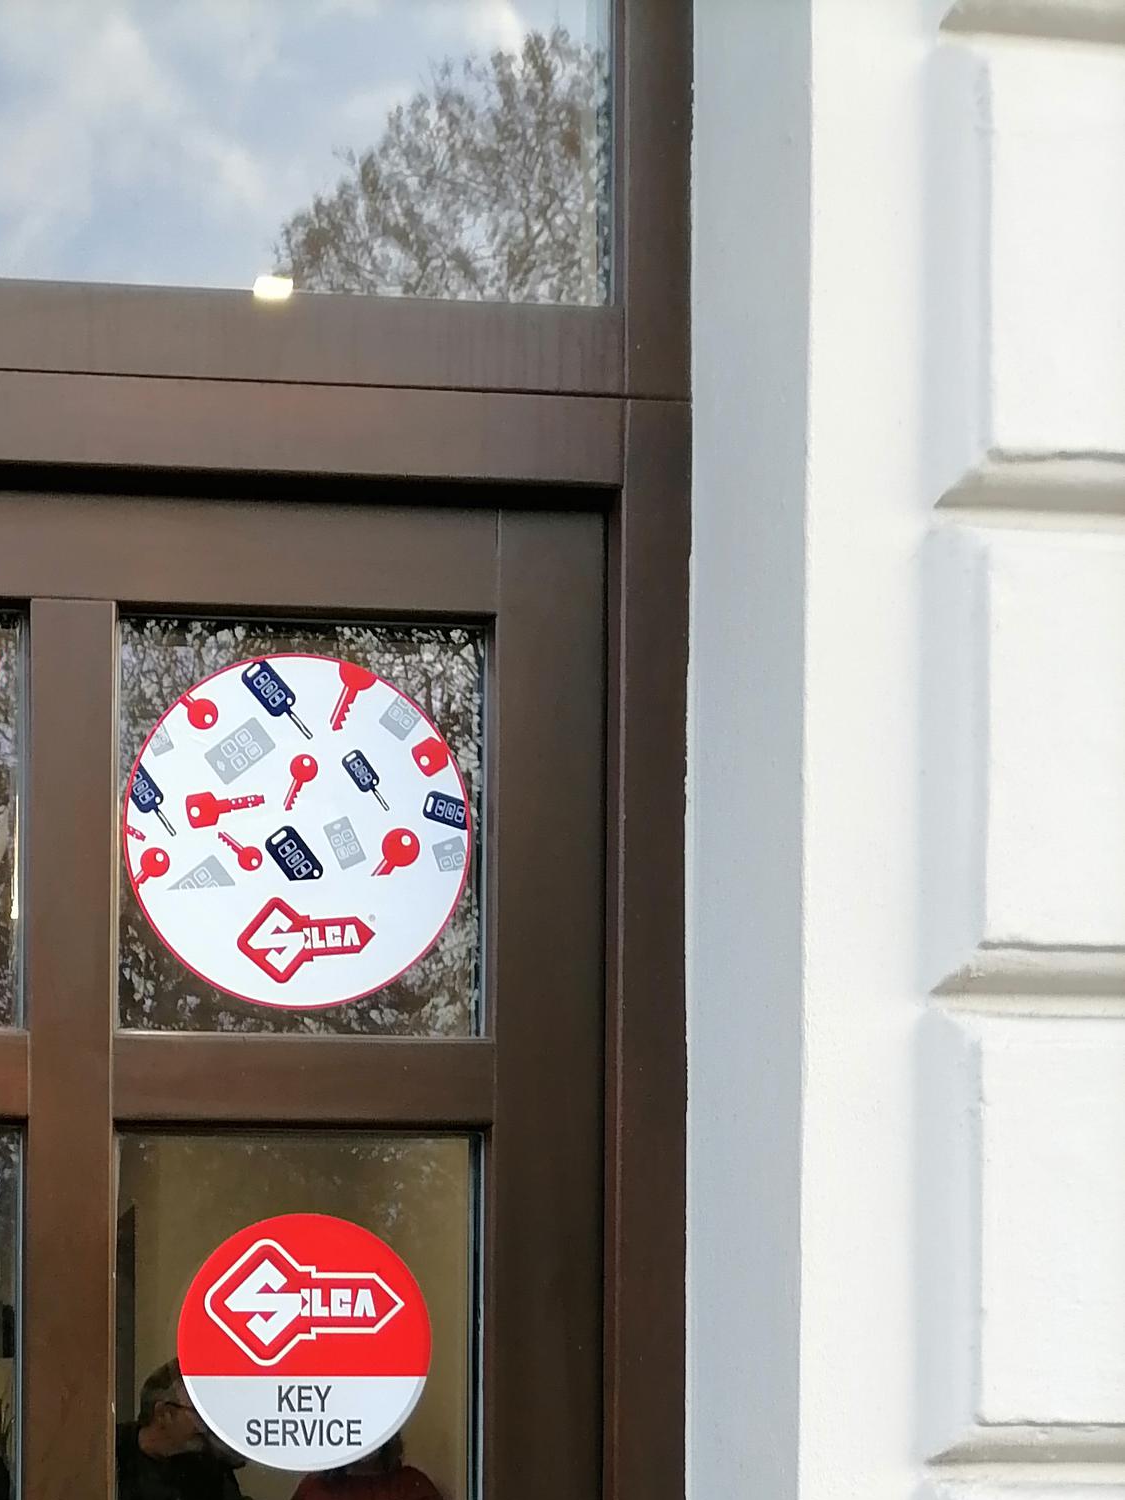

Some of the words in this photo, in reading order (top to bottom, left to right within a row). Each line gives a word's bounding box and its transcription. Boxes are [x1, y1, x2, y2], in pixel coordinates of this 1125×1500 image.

[246, 907, 362, 975] SILCA
[224, 1258, 377, 1347] SILCA
[277, 1385, 332, 1413] KEY
[245, 1419, 362, 1447] SERVICE
